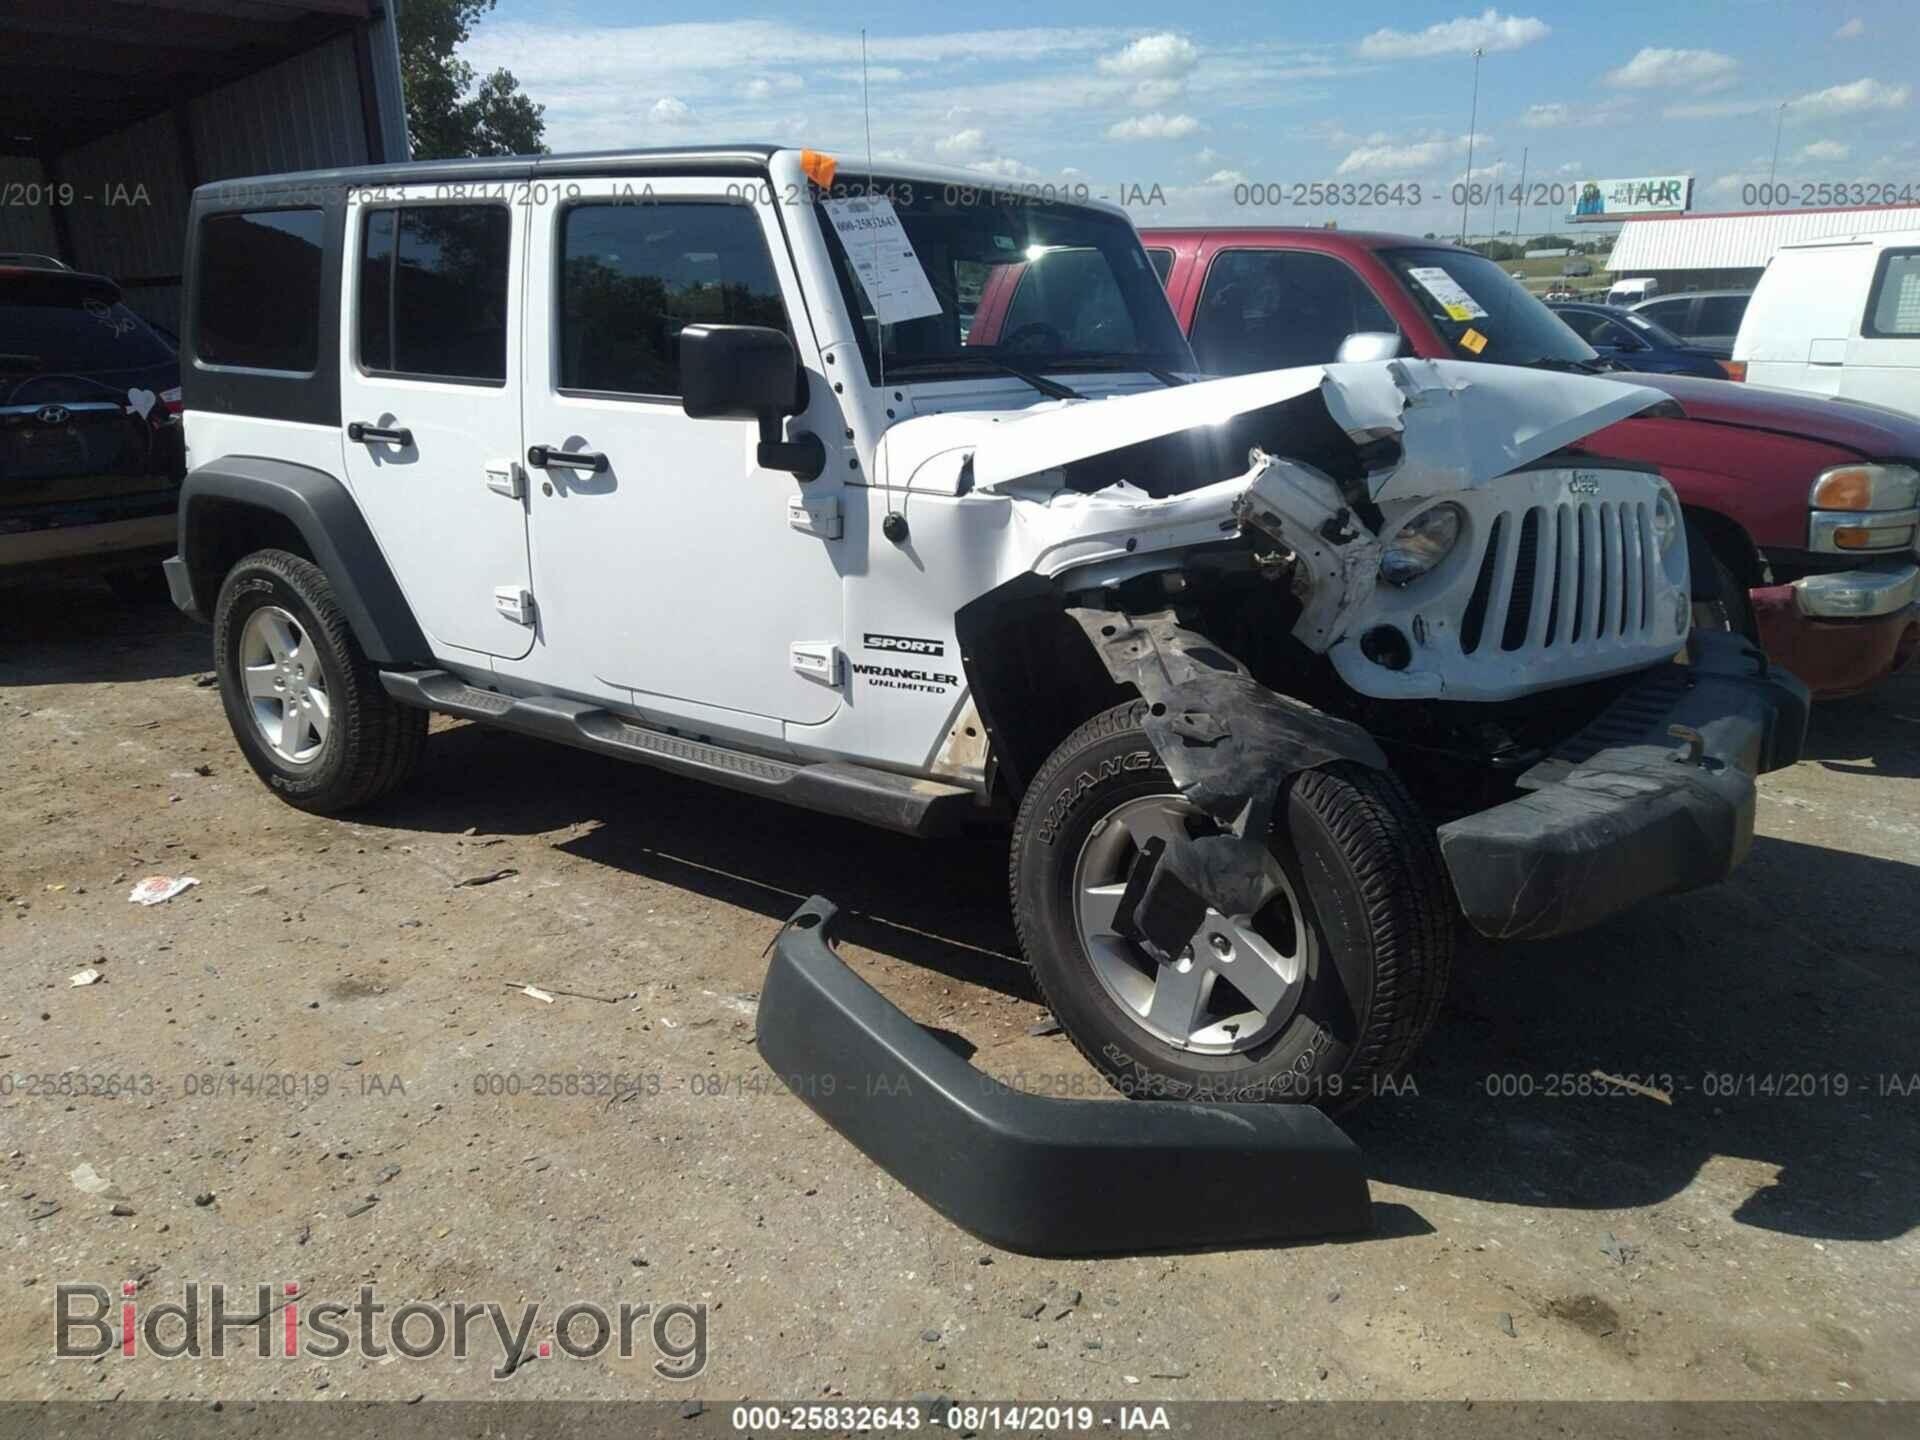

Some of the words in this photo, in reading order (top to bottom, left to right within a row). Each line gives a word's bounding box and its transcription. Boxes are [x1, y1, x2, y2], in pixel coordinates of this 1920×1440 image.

[864, 636, 944, 654] SPORT
[852, 664, 959, 687] WRANGLER
[869, 679, 946, 694] UNLIMITED
